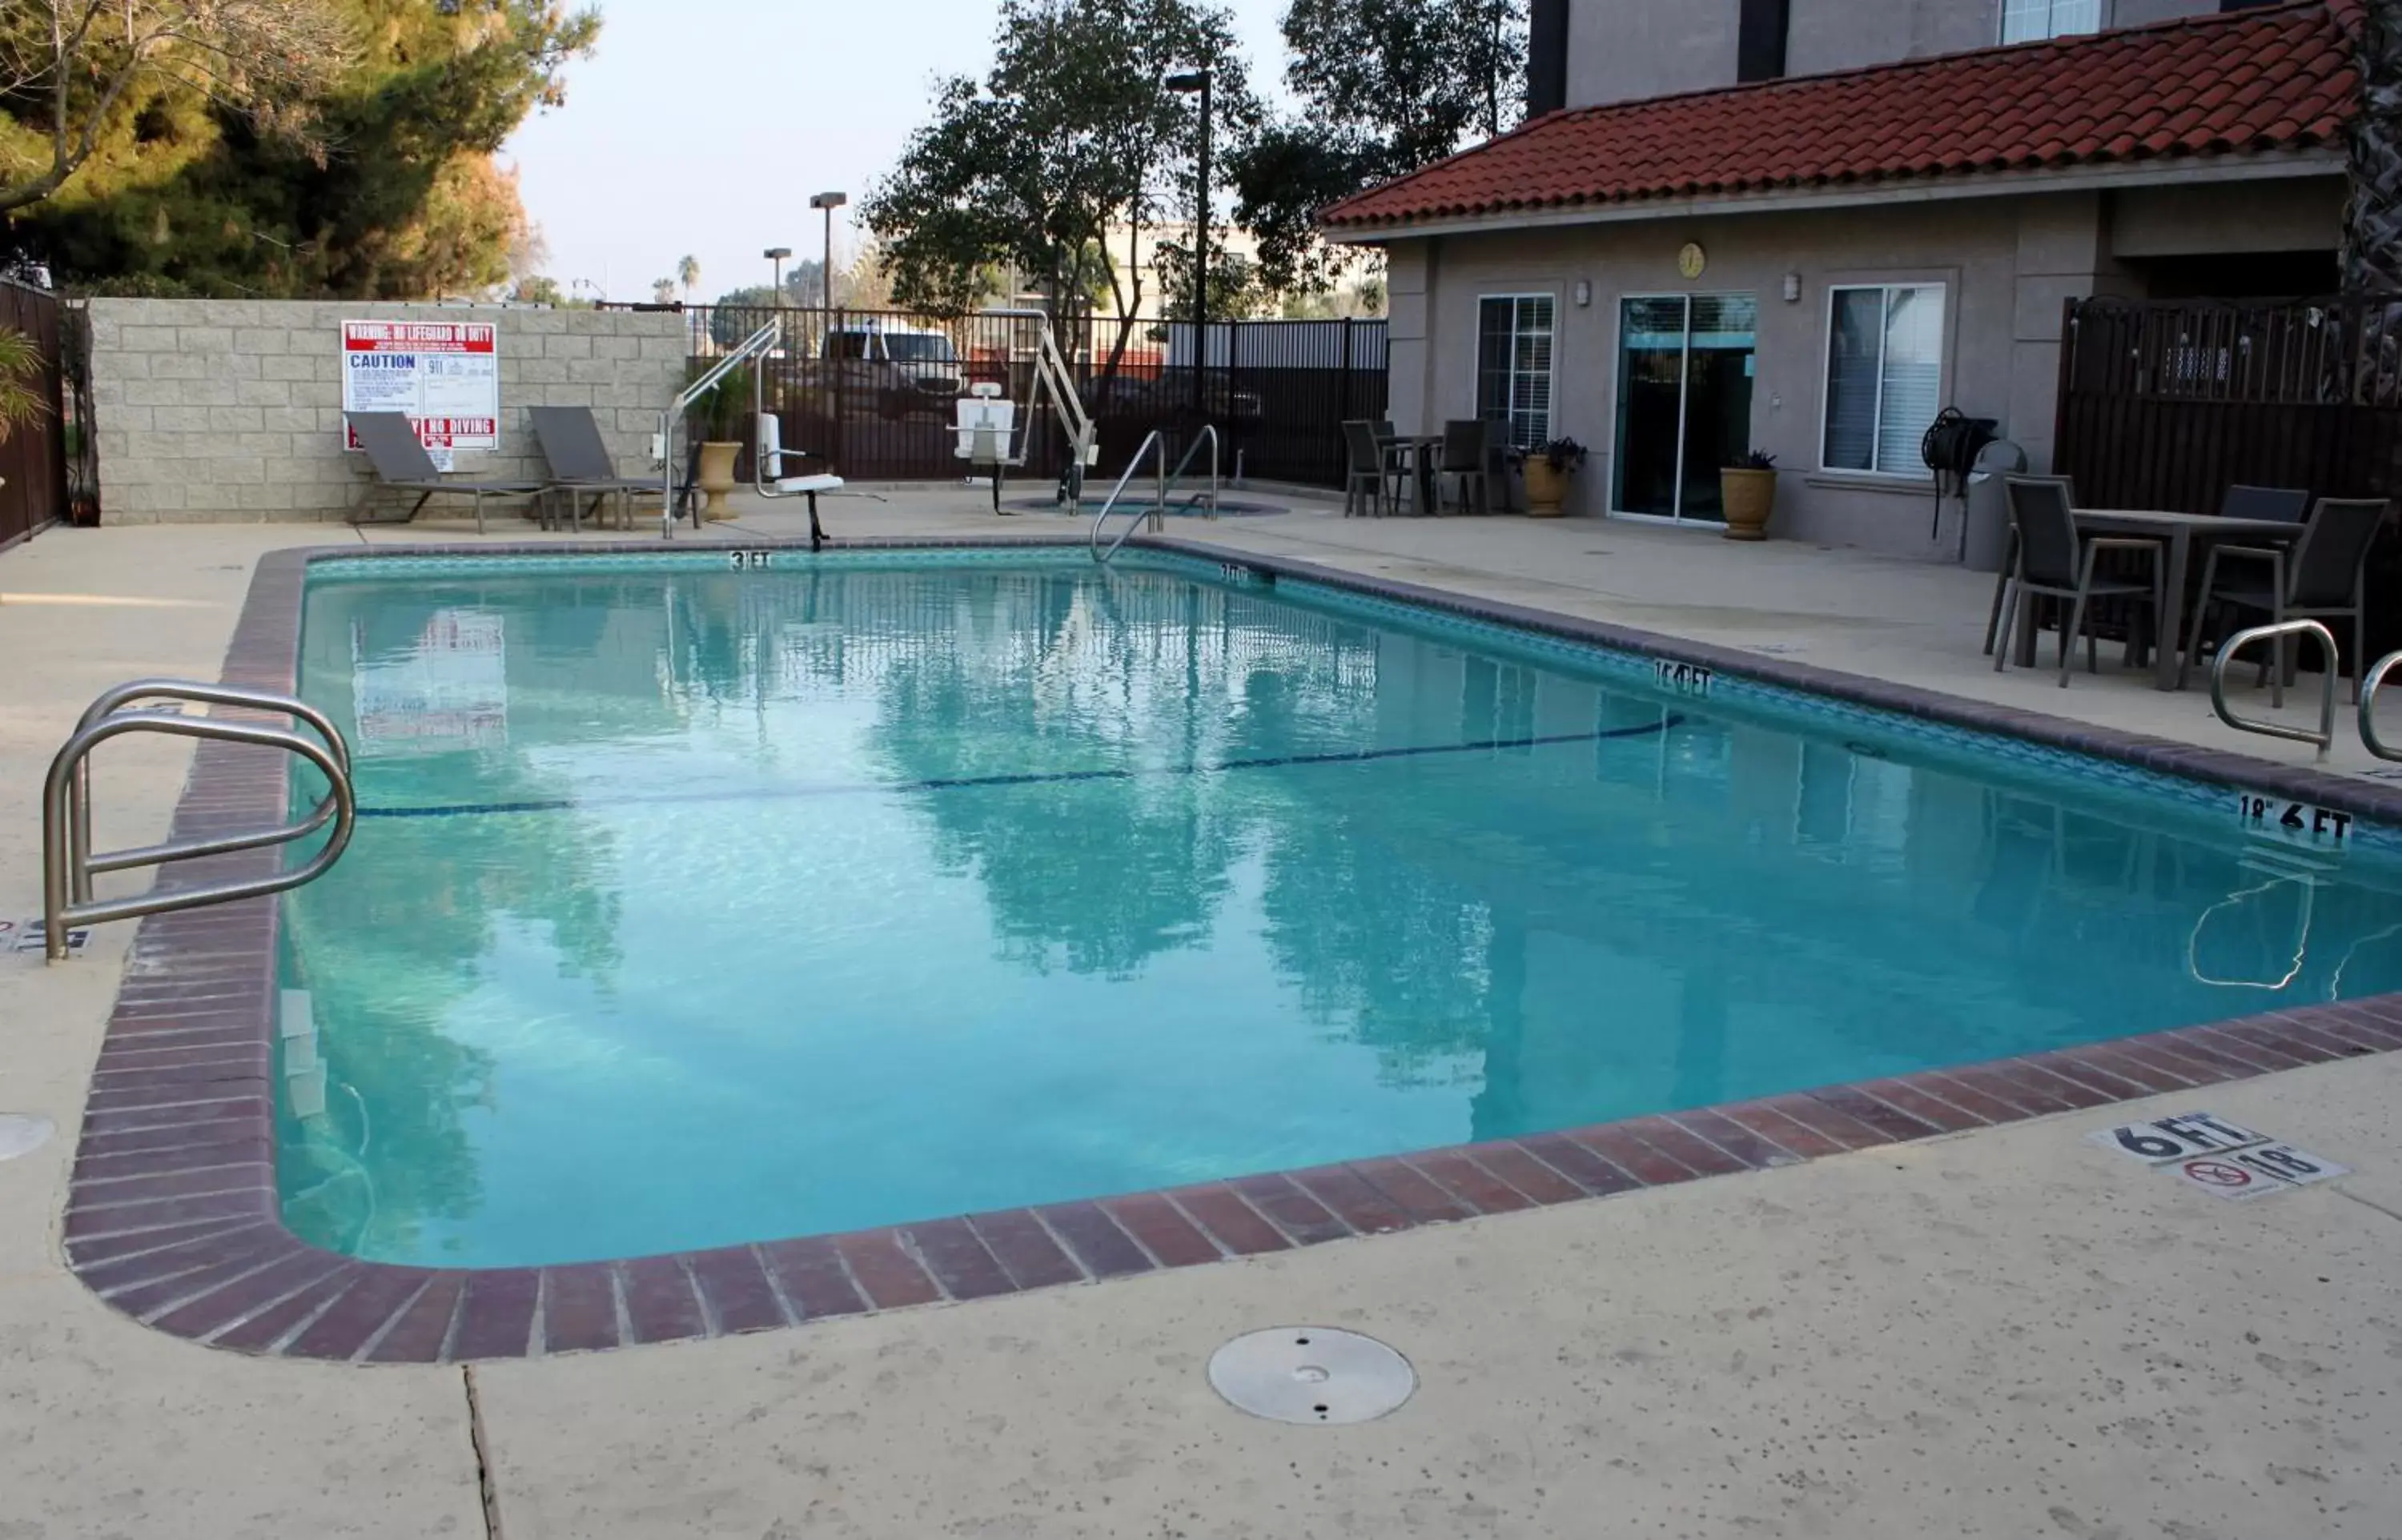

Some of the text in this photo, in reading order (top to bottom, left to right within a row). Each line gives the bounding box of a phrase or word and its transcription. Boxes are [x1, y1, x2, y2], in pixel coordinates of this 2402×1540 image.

[408, 326, 452, 341] LIFEGUARD
[468, 326, 491, 342] DUTY
[350, 355, 416, 368] CAUTION
[429, 360, 444, 374] 911
[430, 419, 444, 434] NO
[451, 419, 491, 434] DIVING
[2280, 804, 2305, 828] 6
[2313, 808, 2352, 838] FT
[2113, 1112, 2248, 1157] 6 FT
